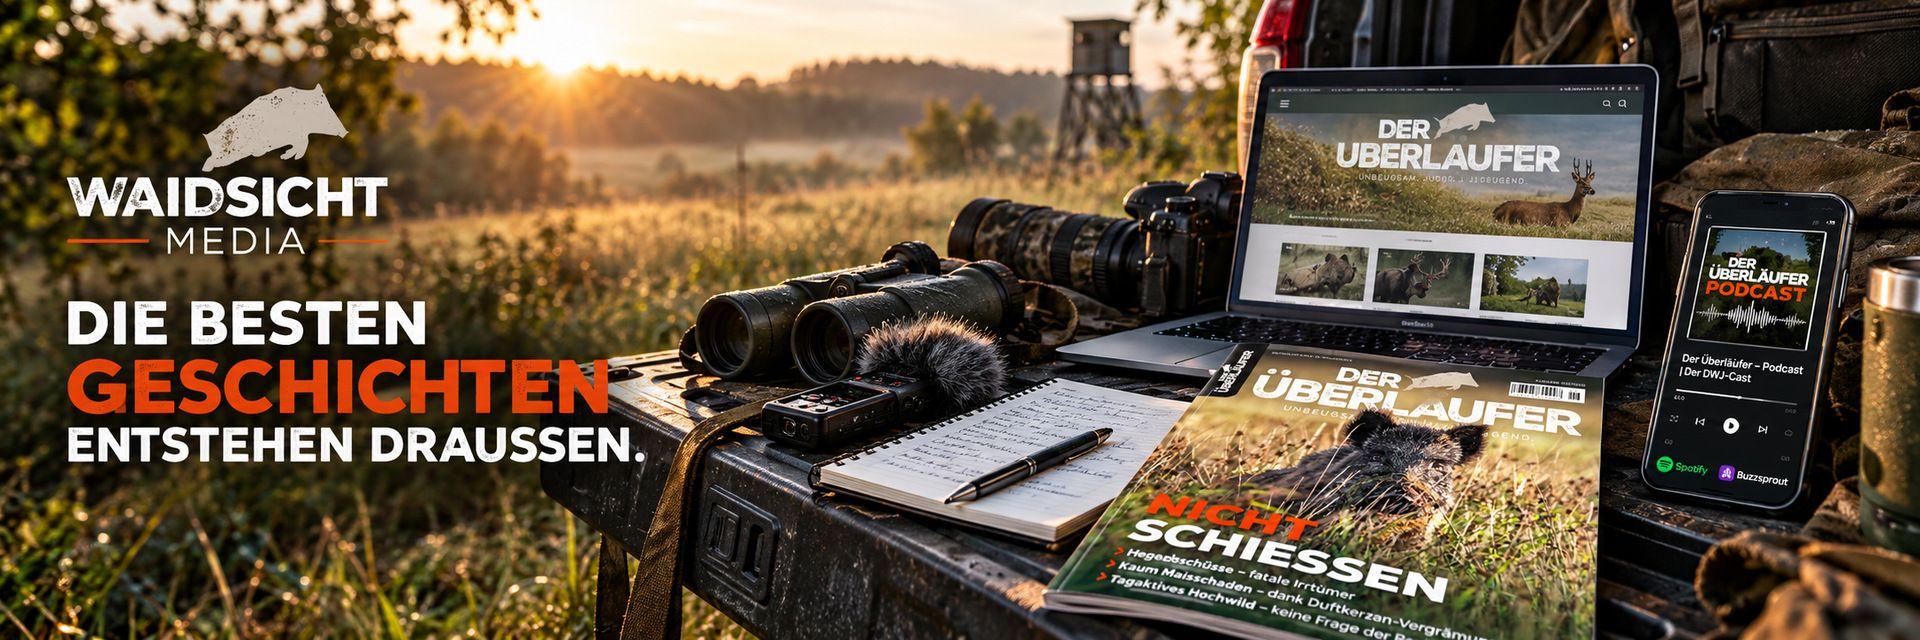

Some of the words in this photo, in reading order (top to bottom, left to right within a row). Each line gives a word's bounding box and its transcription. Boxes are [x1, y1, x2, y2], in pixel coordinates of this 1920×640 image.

[1378, 119, 1431, 140] DER
[1728, 257, 1757, 269] DER
[1708, 264, 1809, 286] ÜBERLÄUFER
[1705, 280, 1807, 302] PODCAST
[1682, 353, 1700, 363] Der
[1701, 353, 1753, 369] Überläufer
[1762, 361, 1804, 375] Podcast
[1684, 366, 1701, 377] Der
[1702, 368, 1752, 383] DWJ-Cast
[1336, 366, 1402, 389] DER
[1675, 462, 1709, 476] Spotify
[1736, 470, 1789, 486] Buzzsprout
[1147, 493, 1319, 542] NICHT
[1127, 518, 1449, 604] SCHIESSEN
[1118, 561, 1159, 576] Kaum
[1161, 567, 1253, 594] Maisschaden
[1267, 588, 1304, 606] dank
[1249, 569, 1290, 588] fatale
[1293, 579, 1356, 601] Irrtümer
[1110, 574, 1185, 596] Tagaktives
[1188, 587, 1256, 611] Hochwild
[1271, 604, 1312, 624] keine
[1315, 615, 1359, 634] Frage
[1363, 627, 1392, 640] der
